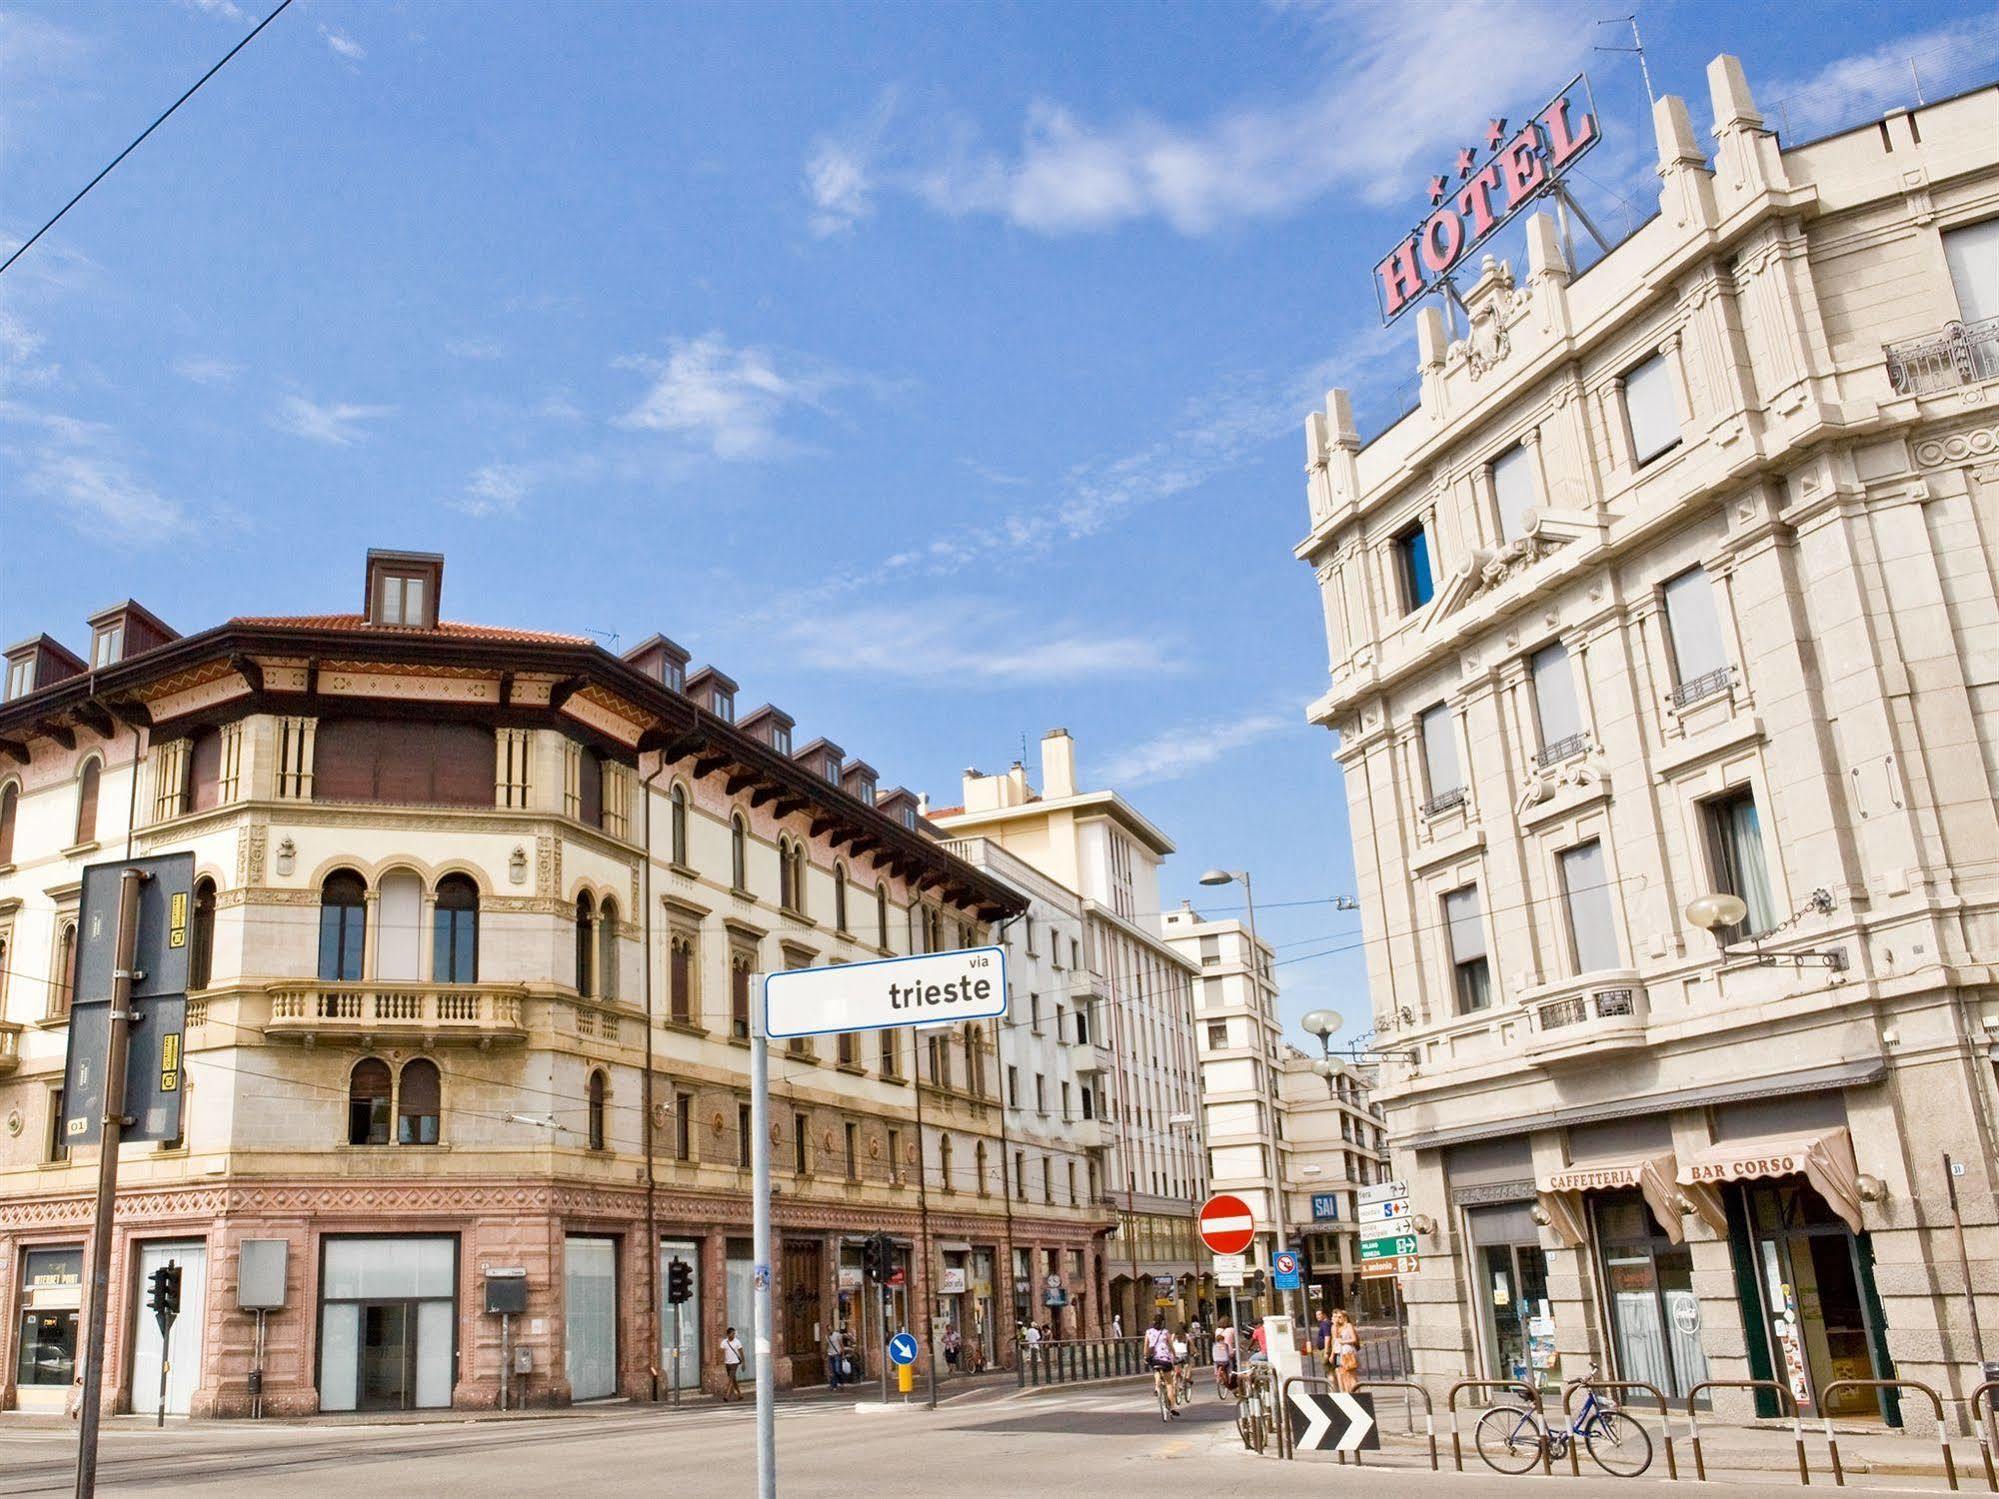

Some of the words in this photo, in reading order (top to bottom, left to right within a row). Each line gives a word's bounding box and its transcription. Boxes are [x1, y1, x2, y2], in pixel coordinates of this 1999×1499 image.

[1377, 97, 1599, 316] HOTEL
[969, 956, 989, 968] via
[889, 975, 990, 1009] trieste
[1691, 1164, 1726, 1180] BAR
[1733, 1157, 1795, 1176] CORSO
[1550, 1170, 1635, 1189] CAFFETTERIA
[1315, 1198, 1335, 1216] SAI
